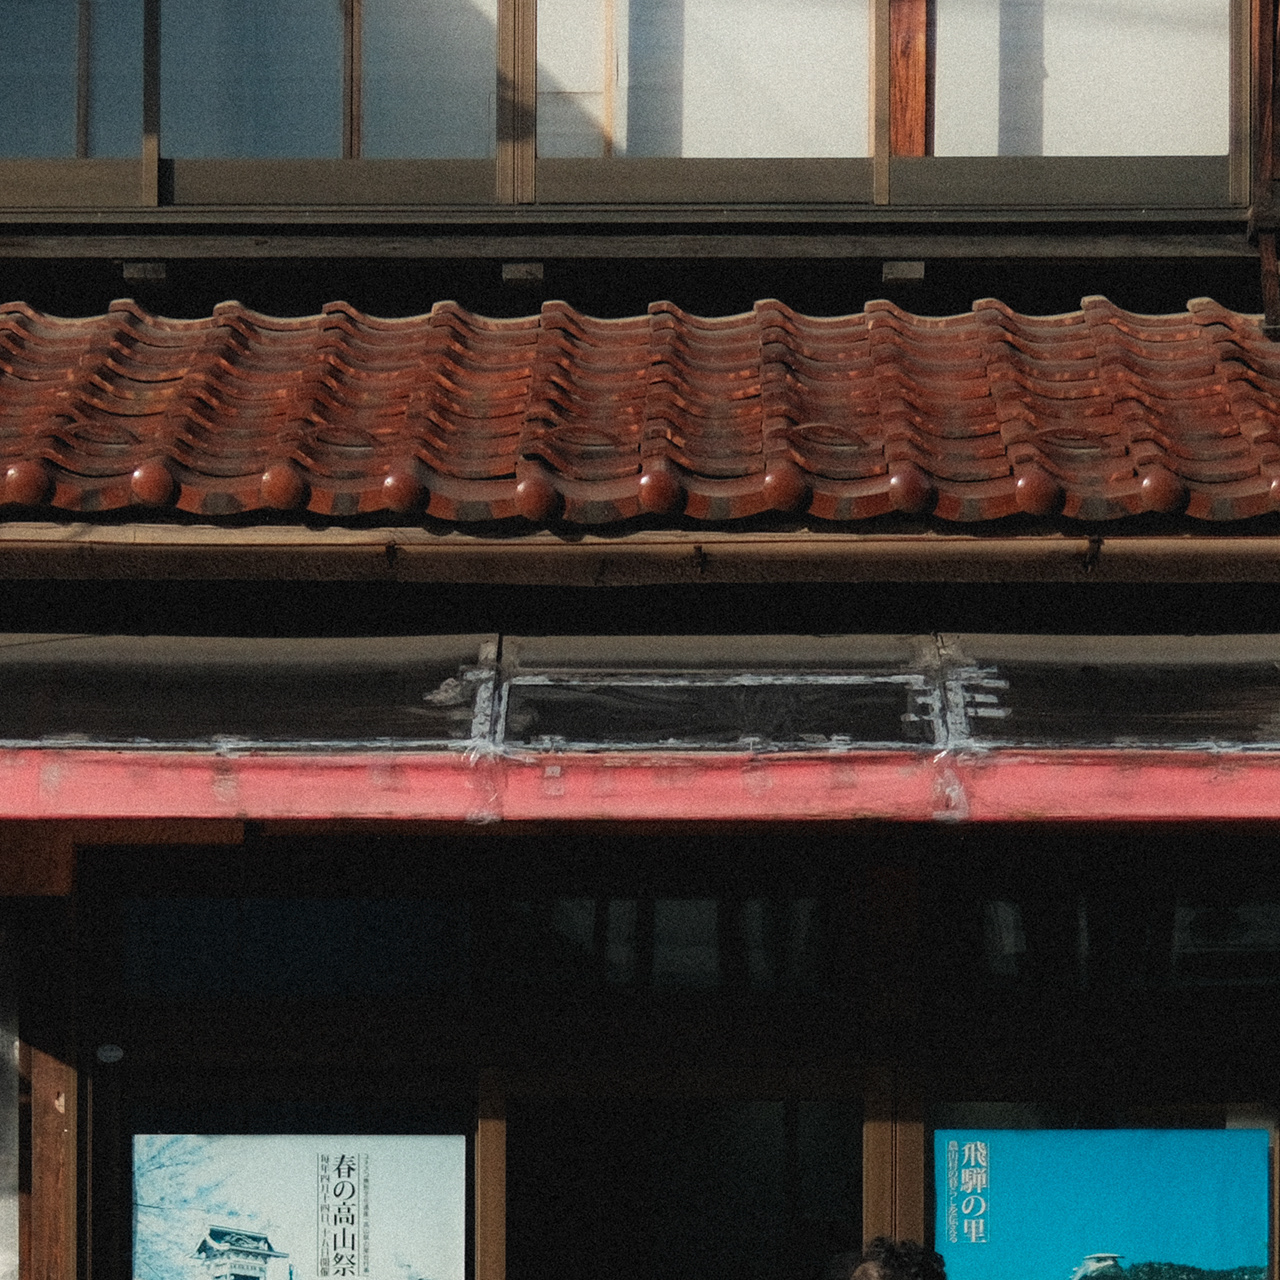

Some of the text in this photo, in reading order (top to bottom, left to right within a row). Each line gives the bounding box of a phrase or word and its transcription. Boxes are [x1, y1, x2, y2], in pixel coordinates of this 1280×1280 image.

[333, 1154, 356, 1277] 春の高山祭
[960, 1141, 987, 1243] 飛騨の里
